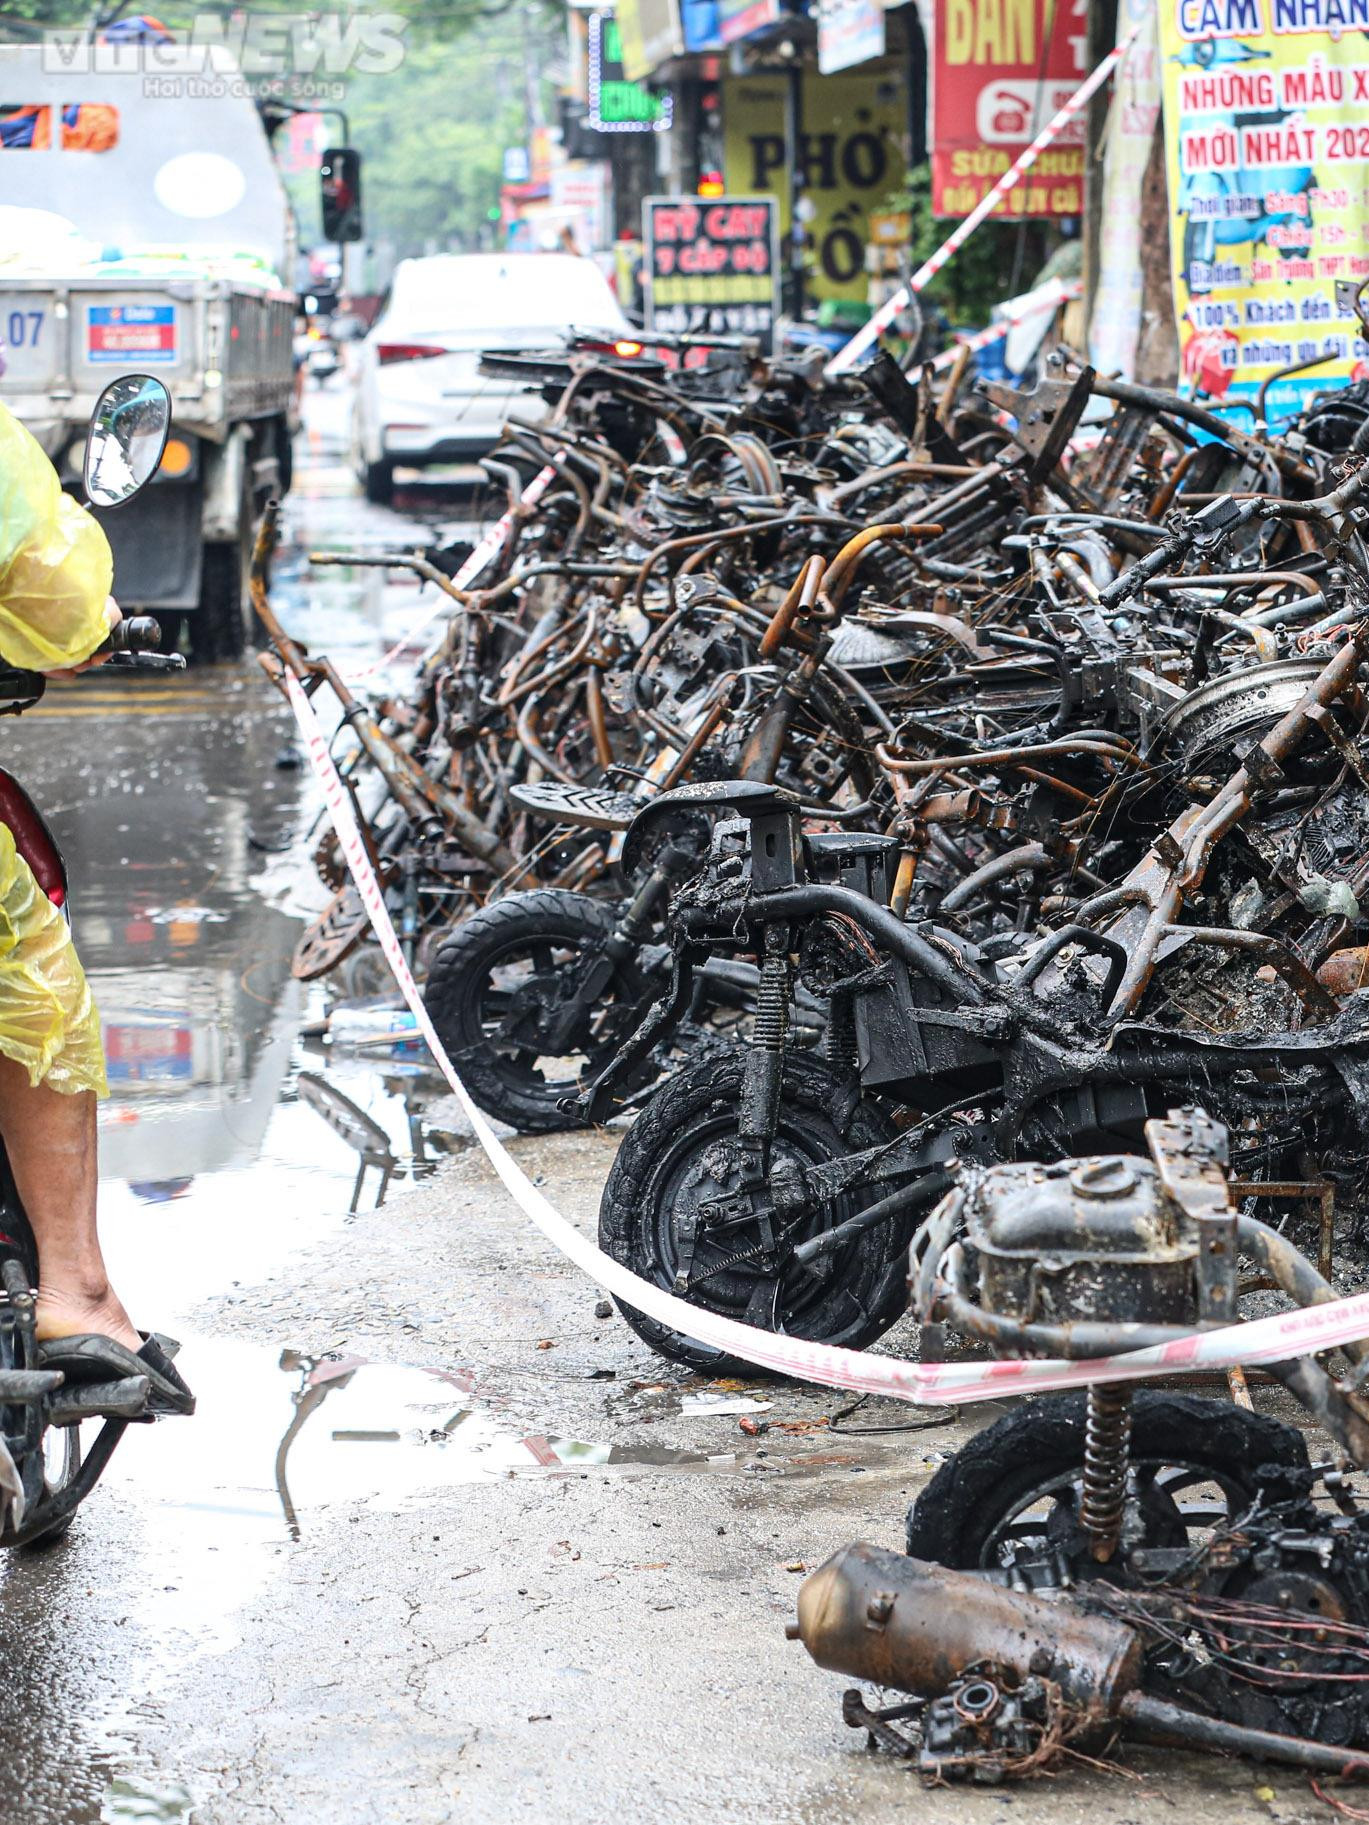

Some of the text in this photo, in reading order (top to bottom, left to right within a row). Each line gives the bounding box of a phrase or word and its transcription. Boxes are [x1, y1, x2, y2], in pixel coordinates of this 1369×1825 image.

[1183, 70, 1273, 109] NHỮNG
[1187, 128, 1236, 167] MỚI
[1245, 117, 1315, 162] NHẤT
